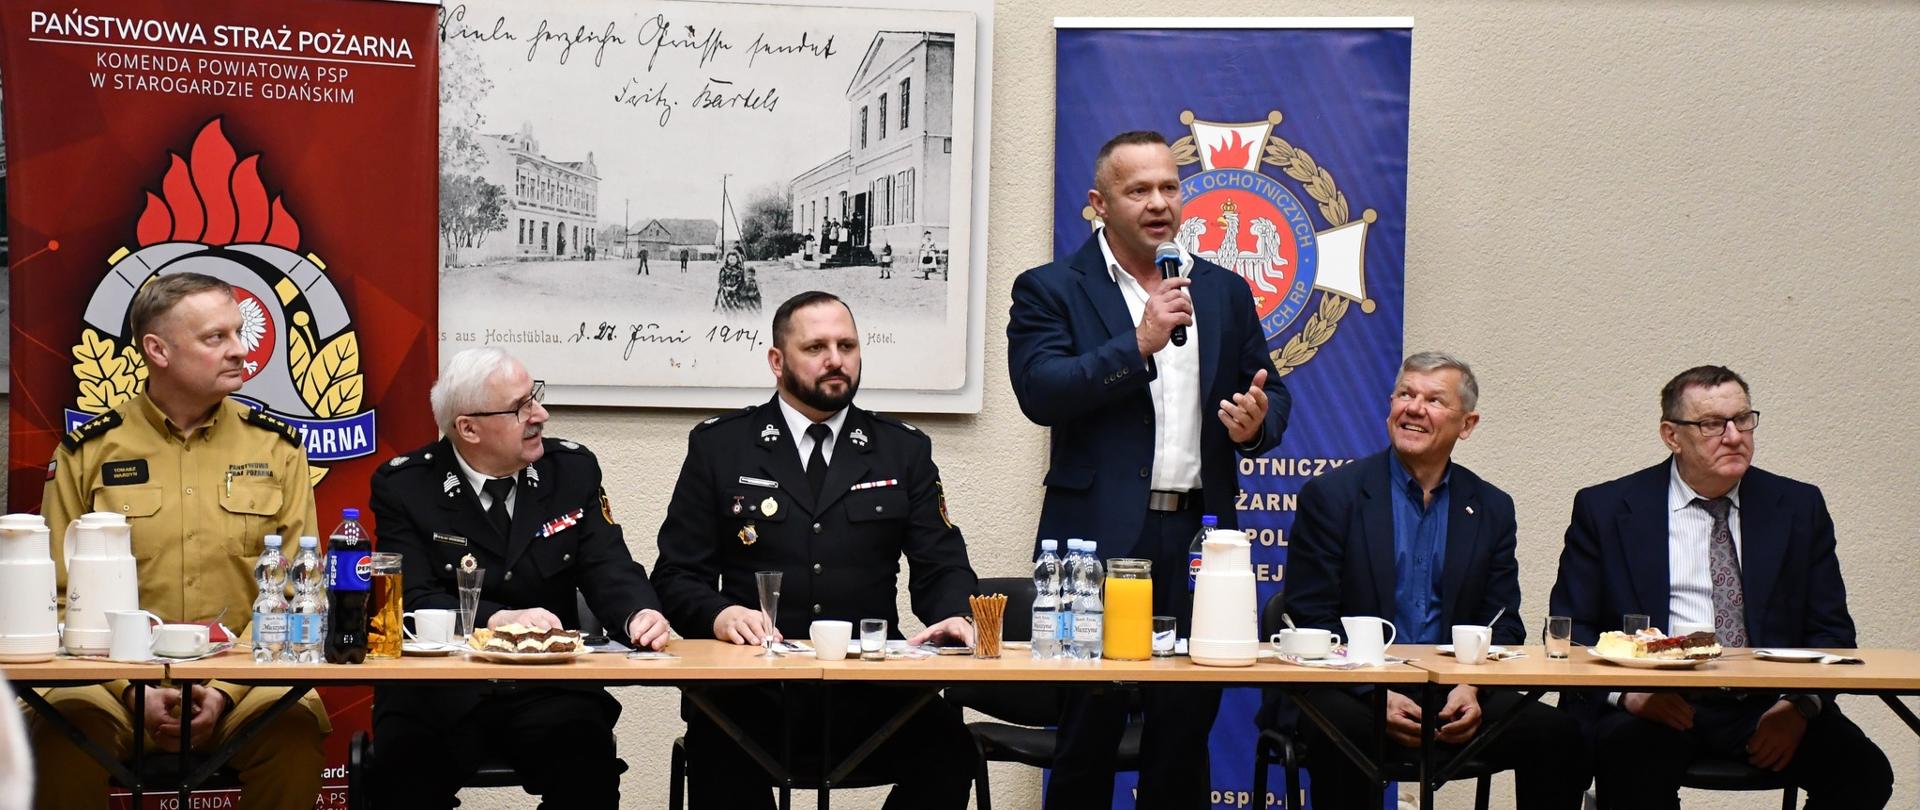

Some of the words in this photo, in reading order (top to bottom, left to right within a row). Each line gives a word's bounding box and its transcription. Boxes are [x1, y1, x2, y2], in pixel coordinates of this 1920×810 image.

[31, 8, 207, 46] PAŃSTWOWA
[213, 25, 293, 52] STRAŻ
[298, 28, 413, 60] POŻARNA
[96, 52, 192, 74] KOMENDA
[199, 59, 311, 82] POWIATOWA
[317, 67, 349, 84] PSP
[90, 72, 106, 88] W
[114, 73, 253, 99] STAROGARDZIE
[261, 81, 355, 104] GDAŃSKIM
[1202, 172, 1313, 248] OCHOTNICZYCH
[1290, 281, 1307, 304] RP
[455, 332, 476, 342] aus
[321, 764, 349, 779] ard-
[160, 796, 232, 810] KOENDA
[330, 792, 346, 805] PS
